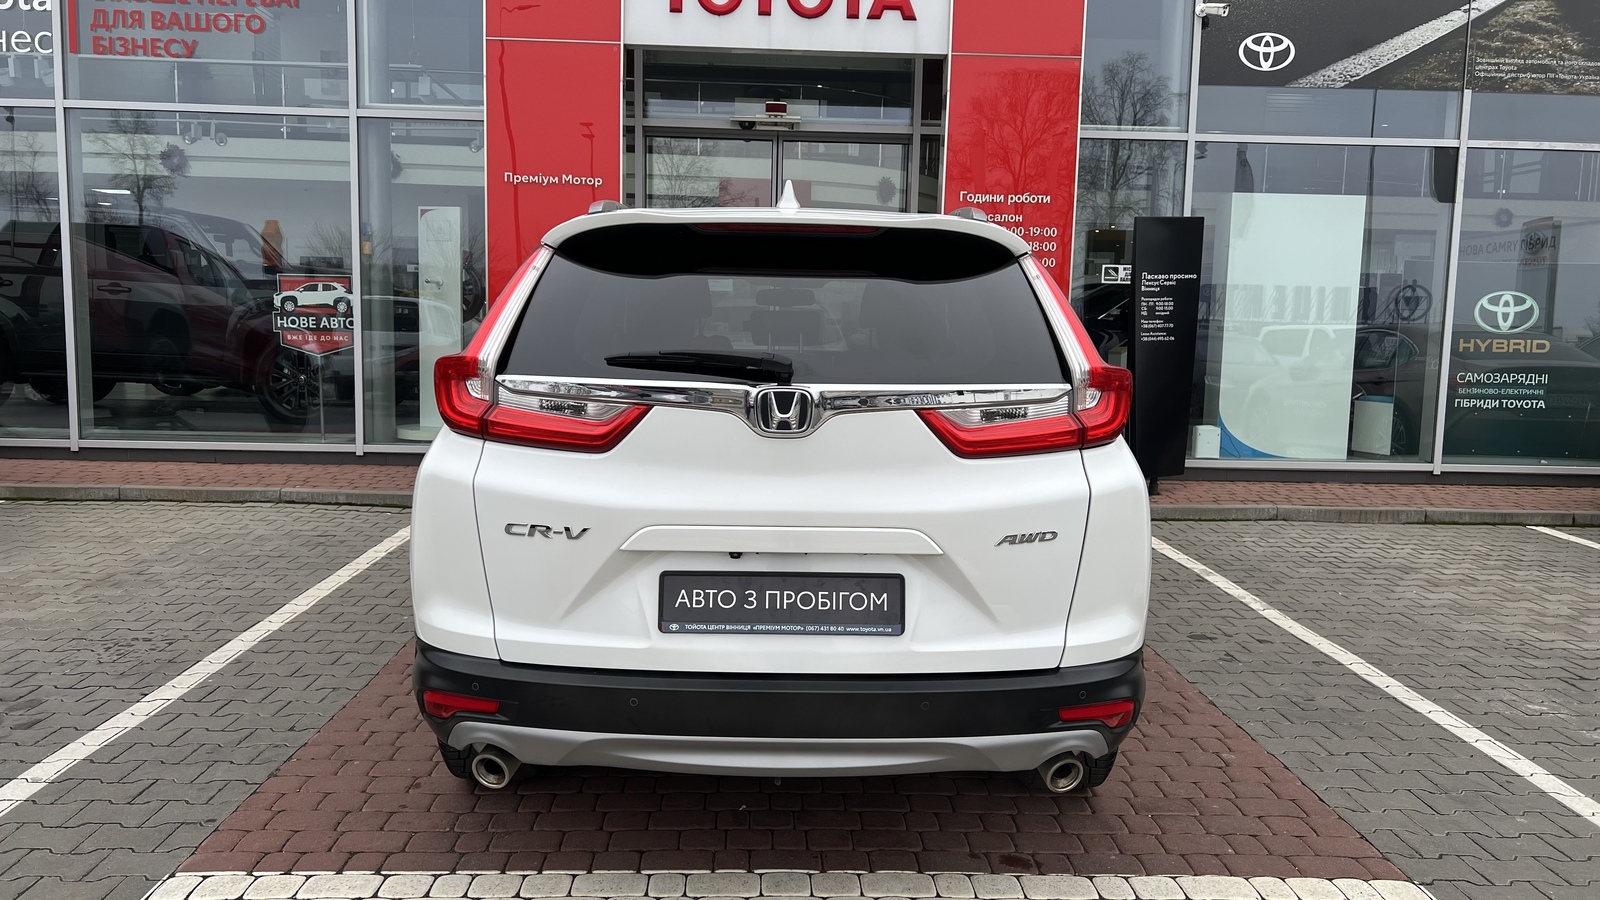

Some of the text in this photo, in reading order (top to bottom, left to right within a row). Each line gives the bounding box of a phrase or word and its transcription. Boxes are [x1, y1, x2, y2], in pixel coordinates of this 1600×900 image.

[90, 8, 266, 34] ДЛЯ ВАШОГО
[92, 35, 197, 58] БІЗНЕСУ
[504, 172, 603, 188] Преміум Мотор
[960, 191, 1051, 205] Години роботи
[1486, 240, 1519, 255] CAMRY
[1141, 272, 1169, 280] Ласкаво
[277, 316, 355, 329] НОВЕ АВТО
[305, 333, 318, 341] ЇДЕ
[1458, 338, 1551, 354] HYBRID
[1456, 372, 1549, 386] САМОЗАРЯДНІ
[1458, 387, 1544, 396] БЕНЗИНОВО-ЕЛЕКТРИЧНІ
[1454, 398, 1500, 409] ГІБРИДИ
[1501, 399, 1546, 409] TOYOTA
[504, 522, 592, 541] CR-V
[994, 530, 1058, 547] AWD
[674, 589, 888, 611] АВТО З ПРОБІГОМ
